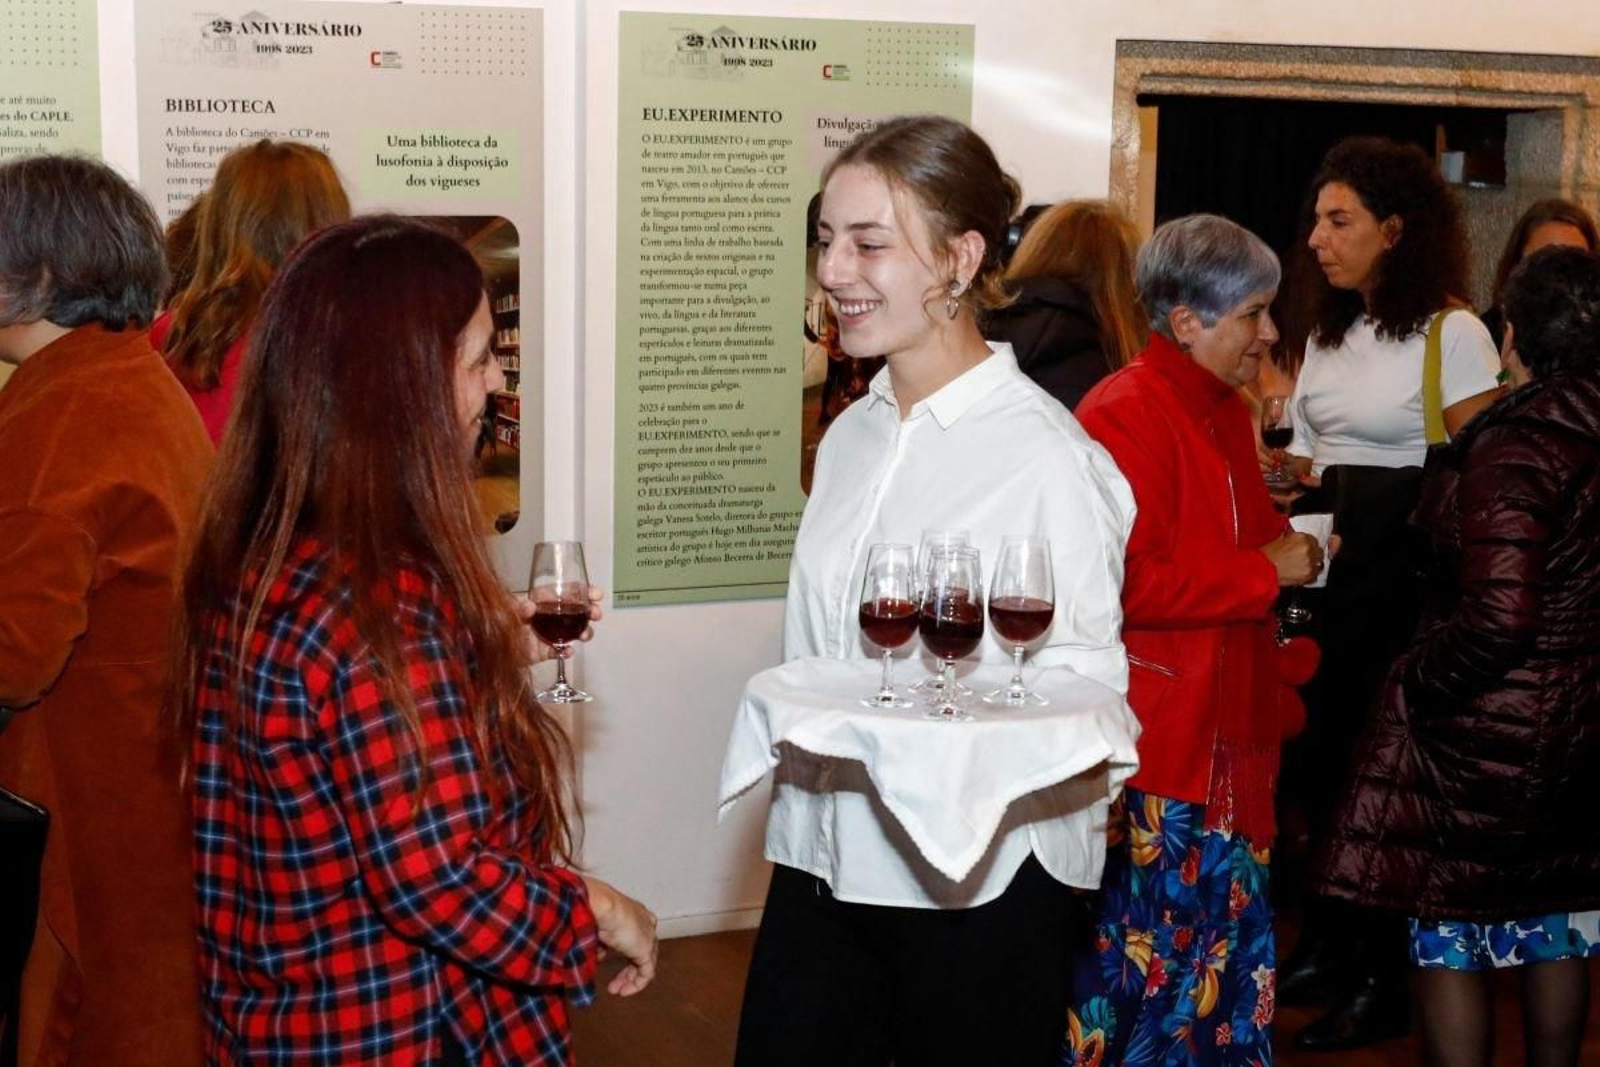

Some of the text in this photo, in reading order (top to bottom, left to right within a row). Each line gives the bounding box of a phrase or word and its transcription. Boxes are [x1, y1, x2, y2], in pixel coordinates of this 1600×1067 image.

[212, 21, 362, 37] 25 ANIVERSÁRIO
[708, 35, 816, 51] ANIVERSÁRIO
[26, 96, 57, 104] muito
[166, 98, 276, 113] BIBLIOTECA
[14, 110, 74, 121] do CAPLE.
[642, 108, 783, 123] EU.EXPERIMENTO
[30, 128, 59, 138] sendo
[177, 127, 222, 137] biblioteca
[226, 128, 238, 138] do
[289, 128, 312, 138] CCP
[387, 134, 498, 148] Uma biblioteca da
[653, 135, 792, 149] EU.EXPERIMENTO grupo
[166, 143, 190, 155] Vigo
[193, 143, 206, 152] faz
[654, 149, 785, 163] teatro amador português que
[376, 154, 432, 167] lusofonia
[447, 154, 508, 170] disposição
[687, 164, 708, 175] 2013,
[725, 164, 756, 175] Camões
[766, 165, 787, 175] CCP
[406, 174, 480, 190] dos vigueses
[657, 178, 680, 192] Vigo,
[710, 179, 743, 192] objetivo
[757, 179, 789, 189] oferecer
[662, 193, 705, 203] ferramenta
[751, 194, 764, 203] dos
[653, 207, 780, 221] língua portuguesa para prática
[653, 222, 678, 235] língua
[681, 224, 702, 232] tanto
[705, 222, 720, 232] oral
[748, 224, 774, 232] escrita.
[641, 237, 661, 246] Com
[684, 237, 704, 246] linha
[719, 237, 751, 246] trabalho
[754, 237, 783, 246] baseada
[653, 251, 756, 264] criação textos originais
[640, 265, 773, 279] experimentação espacial, grupo
[729, 283, 747, 293] peça
[640, 294, 758, 308] importante para divulgação,
[640, 308, 756, 322] vivo, língua literatura
[640, 325, 689, 337] portuguesas,
[692, 326, 716, 336] graças
[734, 322, 772, 332] diferentes
[639, 336, 774, 351] espetáculos leituras dramatizadas
[654, 352, 696, 365] português,
[730, 352, 750, 364] quais
[639, 366, 684, 380] participado
[701, 365, 739, 375] diferentes
[742, 366, 771, 375] eventos
[639, 379, 741, 394] quatro províncias galegas.
[639, 402, 658, 412] 2023
[668, 401, 700, 412] também
[638, 416, 699, 430] celebração para
[732, 427, 754, 438] sendo
[757, 430, 771, 440] que
[638, 447, 676, 458] cumprem
[679, 443, 692, 453] dez
[716, 442, 736, 452] desde
[739, 444, 753, 454] que
[638, 462, 663, 473] grupo
[665, 459, 707, 472] apresentou
[733, 457, 767, 469] primeiro
[638, 470, 724, 486] espetáculo público.
[649, 484, 736, 496] EU.EXPERIMENTO
[638, 496, 763, 511] mão conceituada dramaturga
[637, 514, 663, 528] galega
[666, 513, 693, 524] Vanesa
[696, 512, 722, 523] Sotelo,
[725, 510, 755, 521] diretora
[769, 512, 792, 522] grupo
[637, 529, 666, 538] escritor
[669, 526, 708, 540] português
[712, 525, 733, 538] Hugo
[637, 541, 668, 552] artística
[682, 543, 706, 553] grupo
[715, 538, 732, 552] hoje
[749, 537, 760, 547] dia
[637, 555, 662, 566] crítico
[665, 554, 690, 568] galego
[694, 552, 721, 563] Afonso
[724, 551, 753, 562] Becerra
